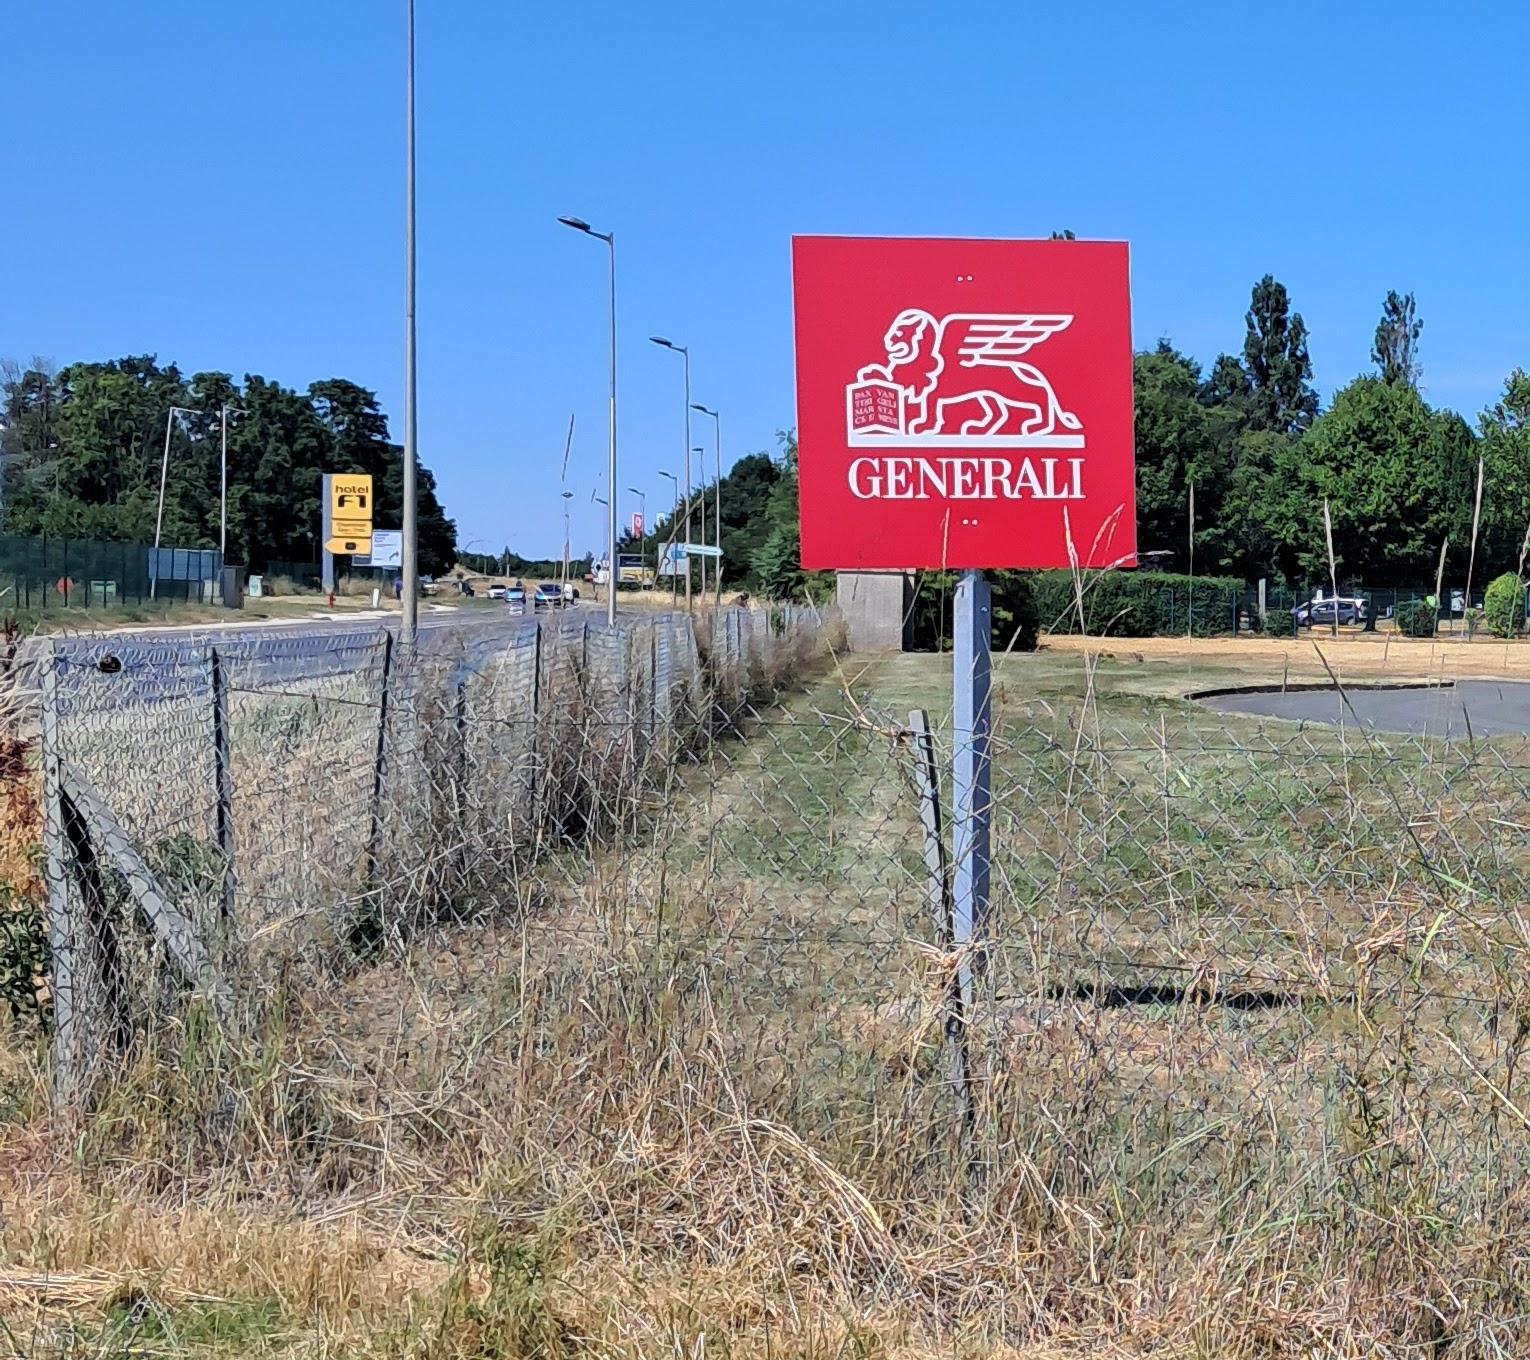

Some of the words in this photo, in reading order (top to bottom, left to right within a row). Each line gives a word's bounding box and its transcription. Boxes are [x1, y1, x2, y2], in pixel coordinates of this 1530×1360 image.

[848, 457, 1086, 499] GENERALI
[335, 485, 369, 493] hotel
[338, 495, 366, 508] F1
